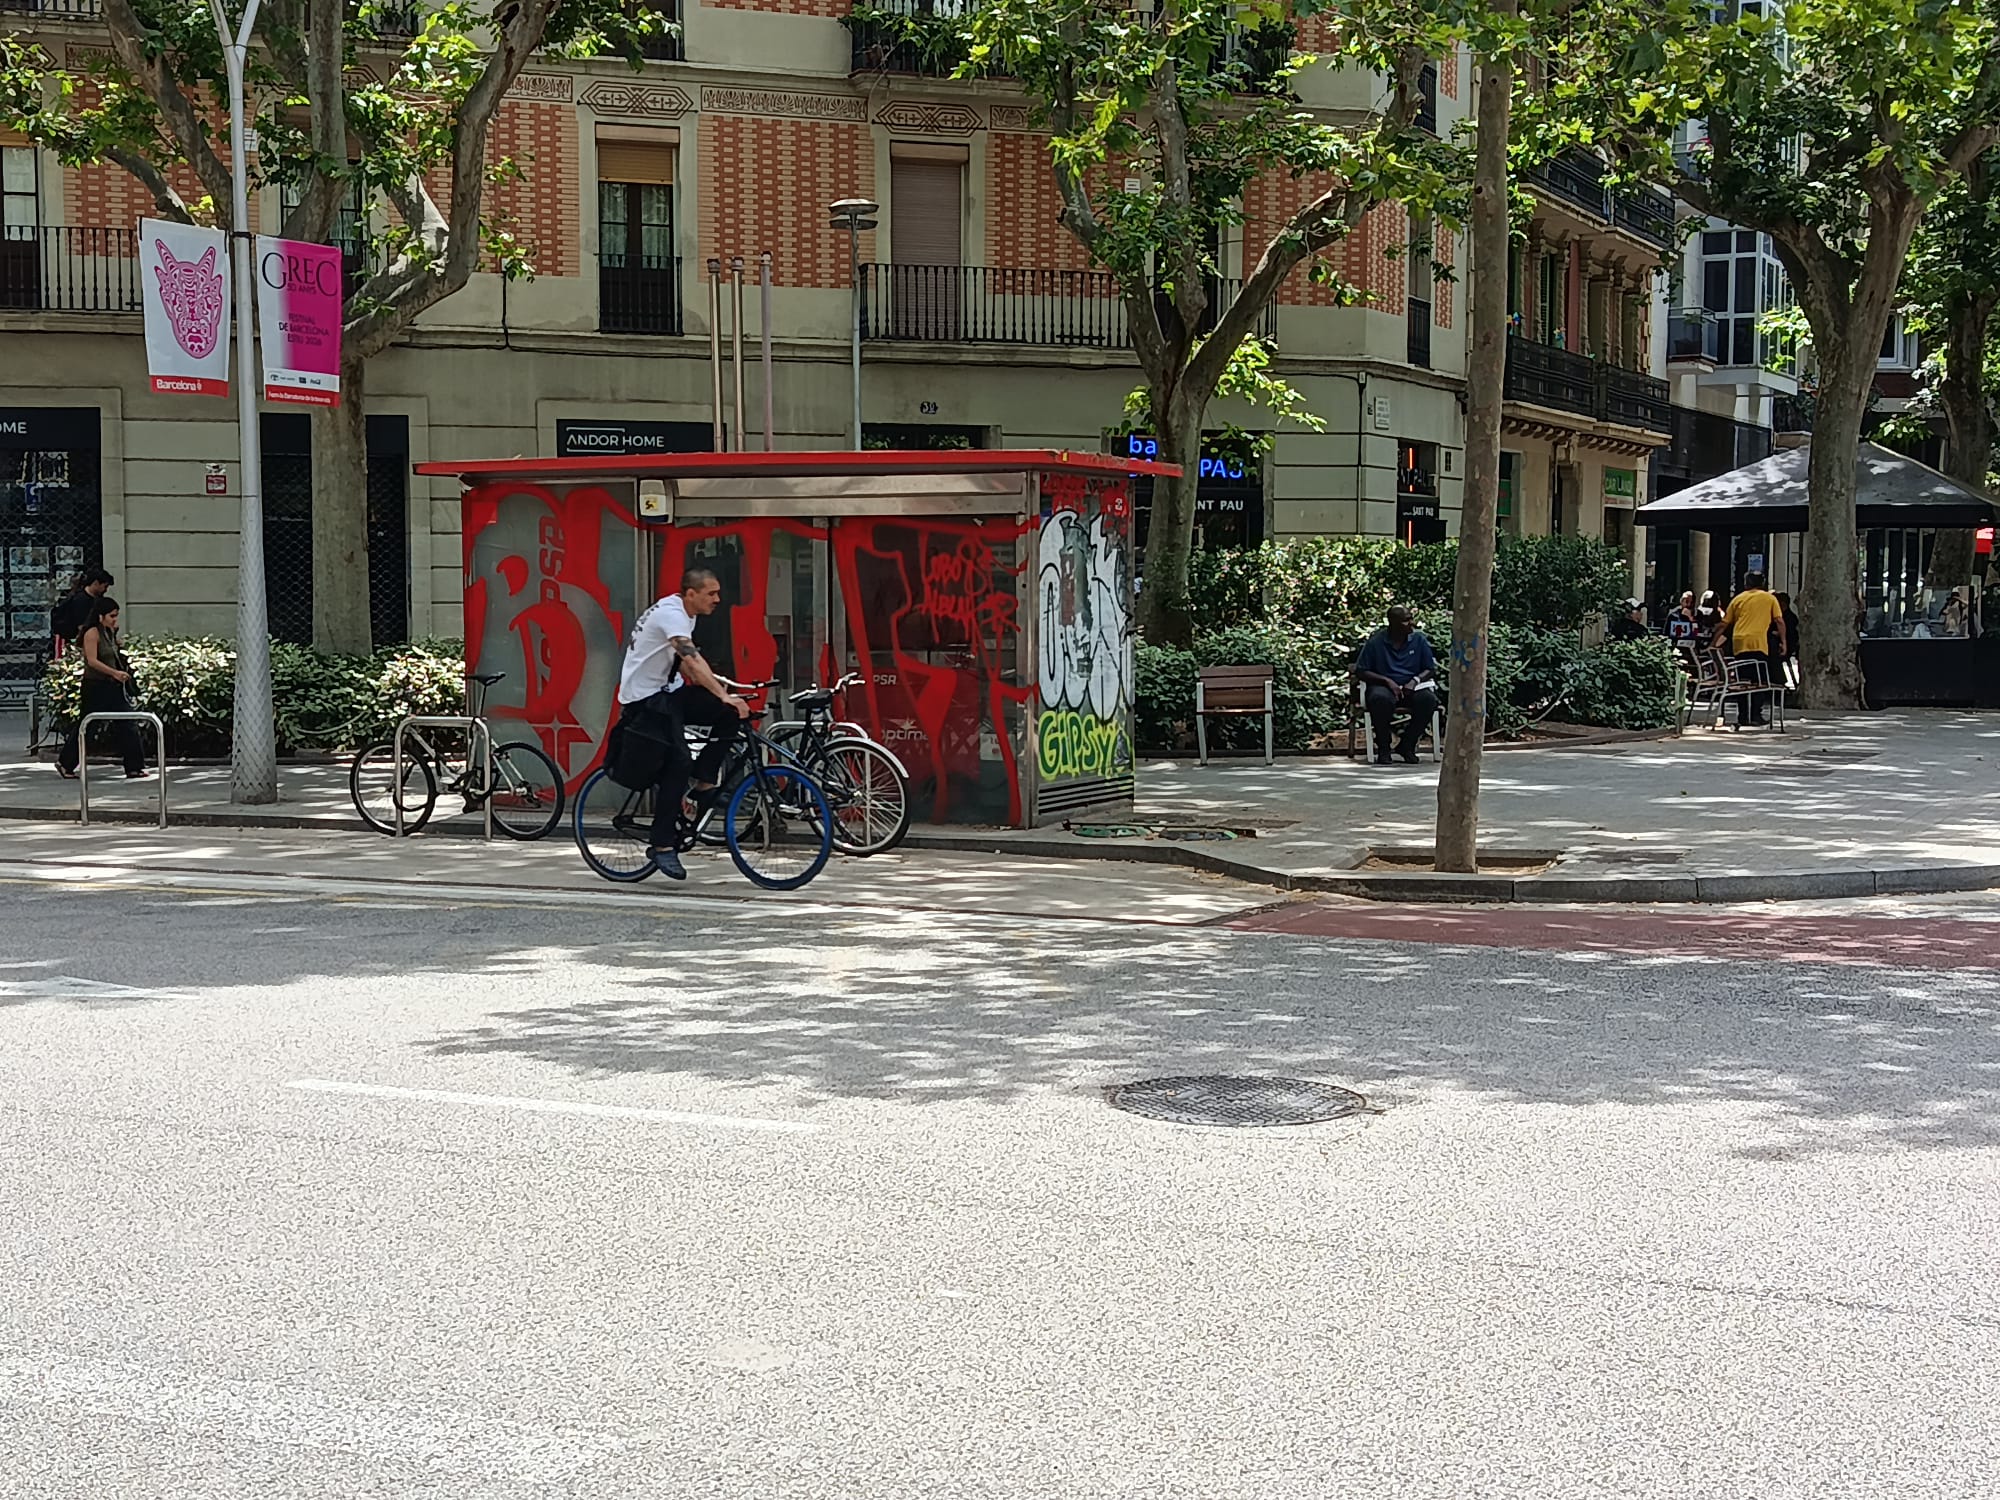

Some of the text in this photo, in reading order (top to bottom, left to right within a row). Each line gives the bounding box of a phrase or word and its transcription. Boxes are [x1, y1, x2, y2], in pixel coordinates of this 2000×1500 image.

[261, 252, 338, 297] GREC
[278, 321, 288, 332] DE
[156, 378, 197, 391] Barcelona
[0, 421, 28, 434] ME
[566, 434, 665, 447] ANDOR HOME
[1219, 500, 1244, 511] PAU
